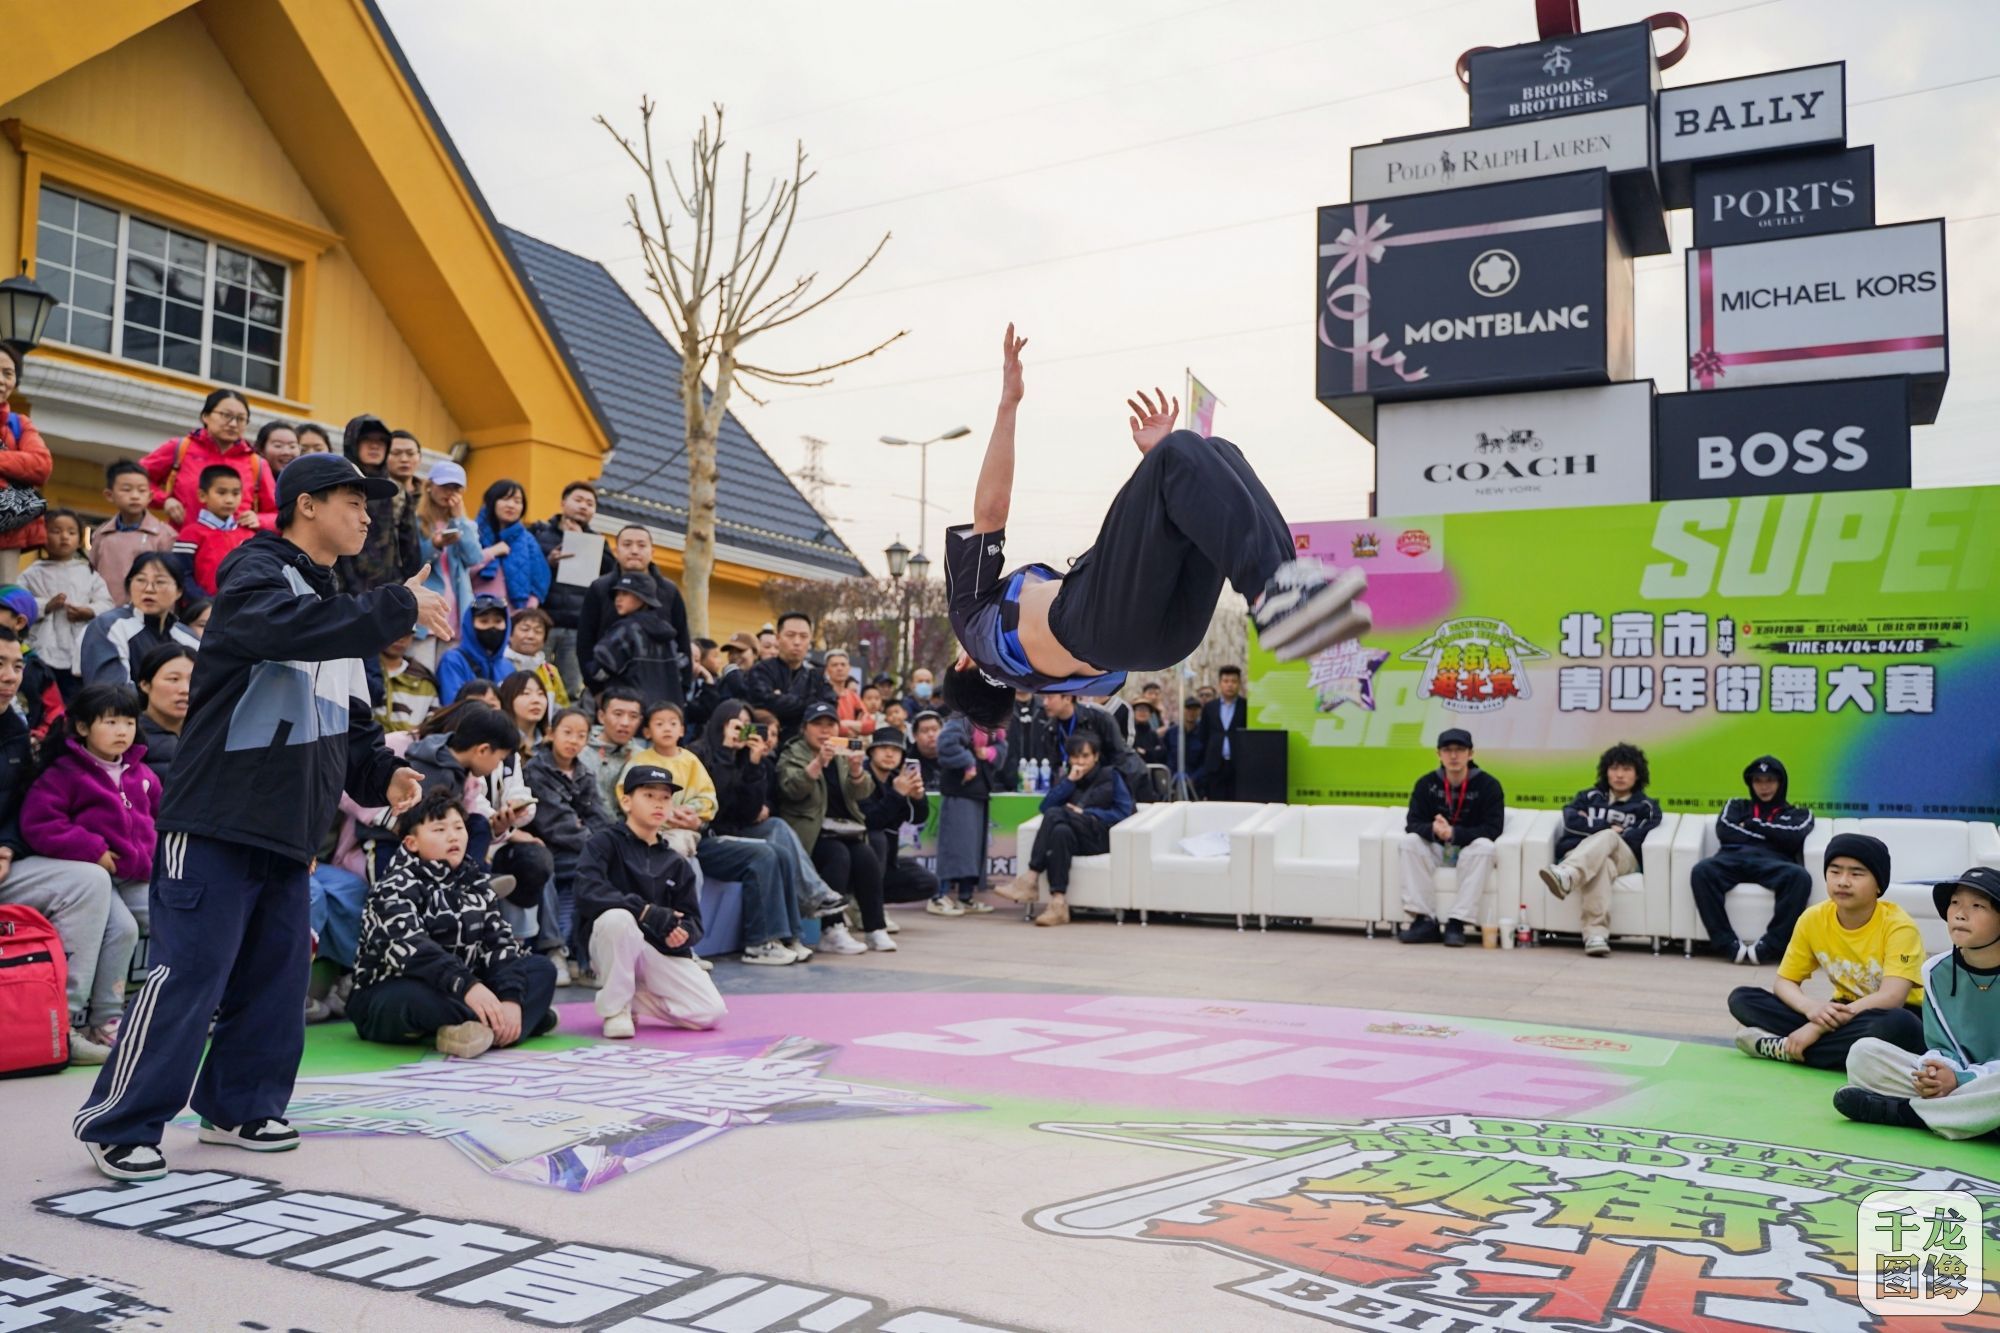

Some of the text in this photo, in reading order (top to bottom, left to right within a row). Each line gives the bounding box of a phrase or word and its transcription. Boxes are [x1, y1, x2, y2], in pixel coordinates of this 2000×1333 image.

[1509, 89, 1609, 117] BROTHERS
[1521, 77, 1595, 101] BROOKS
[1674, 90, 1825, 138] BALLY
[1387, 134, 1613, 184] POLO RALPH LAUREN
[1711, 178, 1856, 222] PORTS
[1757, 214, 1807, 228] OUTLET
[1721, 270, 1938, 312] MICHAEL KORS
[1404, 304, 1590, 346] MONTBLANC
[1423, 454, 1600, 484] COACH
[1698, 425, 1869, 480] BOSS
[1475, 485, 1543, 496] NEW YORK
[1560, 610, 1708, 658] 北京市
[1558, 664, 1935, 713] 青少年街舞大赛
[1350, 1134, 1692, 1168] AROUND
[1472, 1119, 1926, 1183] DANCING
